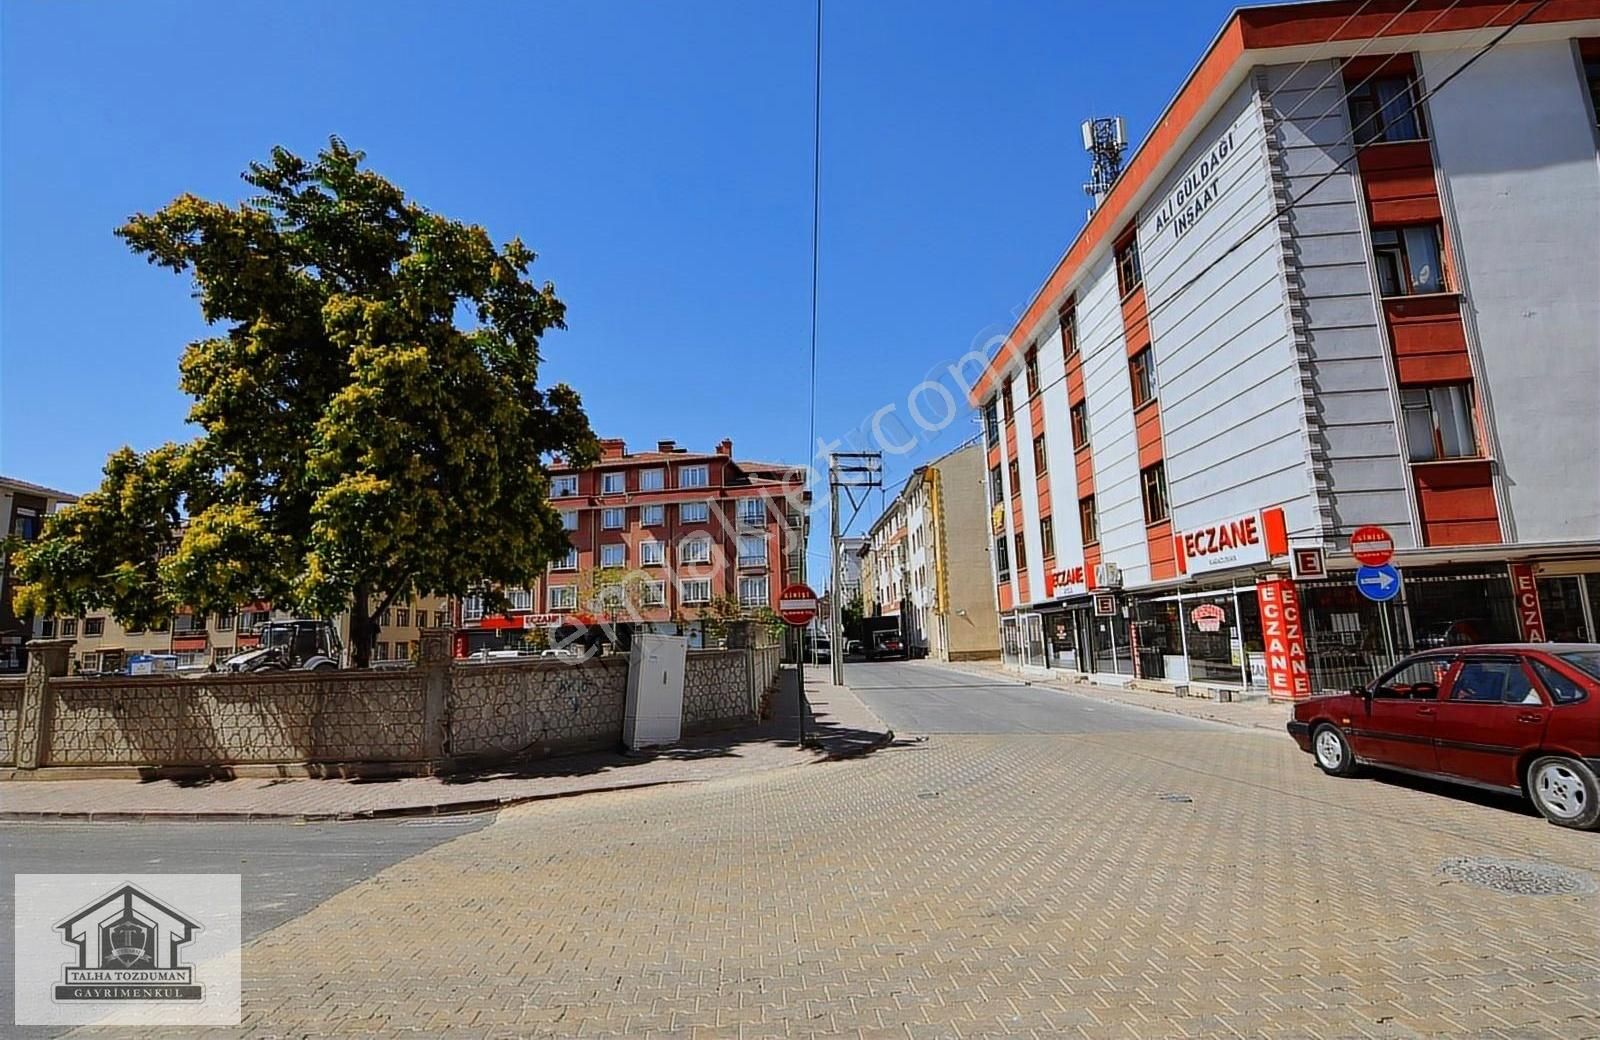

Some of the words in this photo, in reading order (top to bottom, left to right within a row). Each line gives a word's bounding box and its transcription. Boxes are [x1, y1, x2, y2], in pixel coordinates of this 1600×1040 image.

[1184, 515, 1260, 558] ECZANE
[1053, 566, 1084, 588] ECZANE
[1518, 575, 1543, 643] ECZA
[1261, 586, 1289, 688] ECZANE
[1281, 590, 1308, 692] ECZANE
